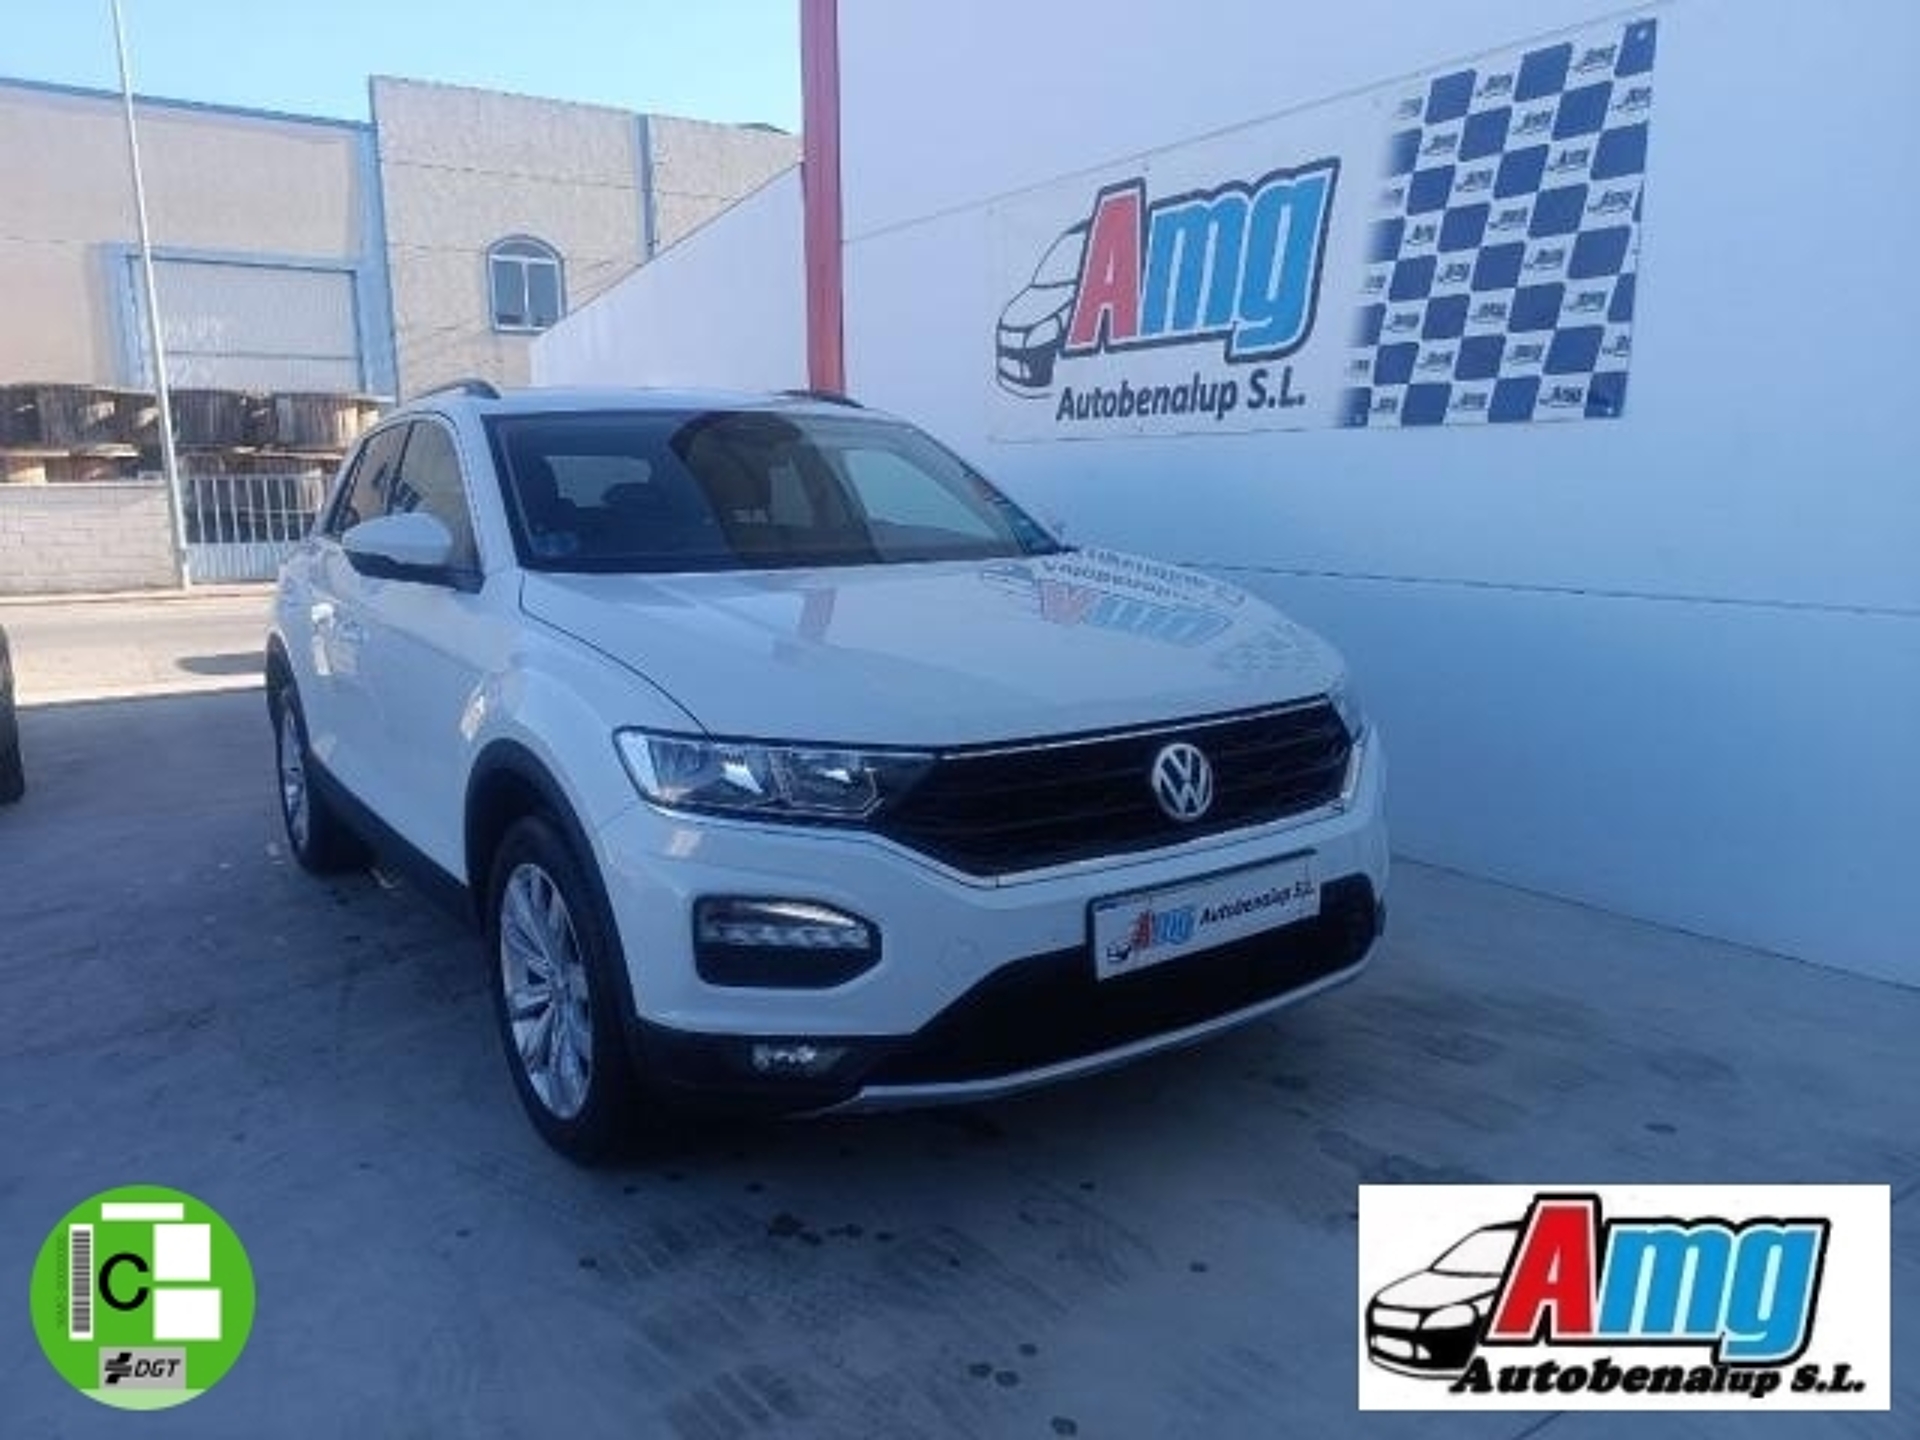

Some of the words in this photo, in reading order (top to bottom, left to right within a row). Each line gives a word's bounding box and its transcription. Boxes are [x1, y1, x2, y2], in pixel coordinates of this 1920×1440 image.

[1058, 157, 1340, 363] Amg
[1056, 372, 1238, 421] Autobenalup
[1247, 366, 1305, 408] S.L.
